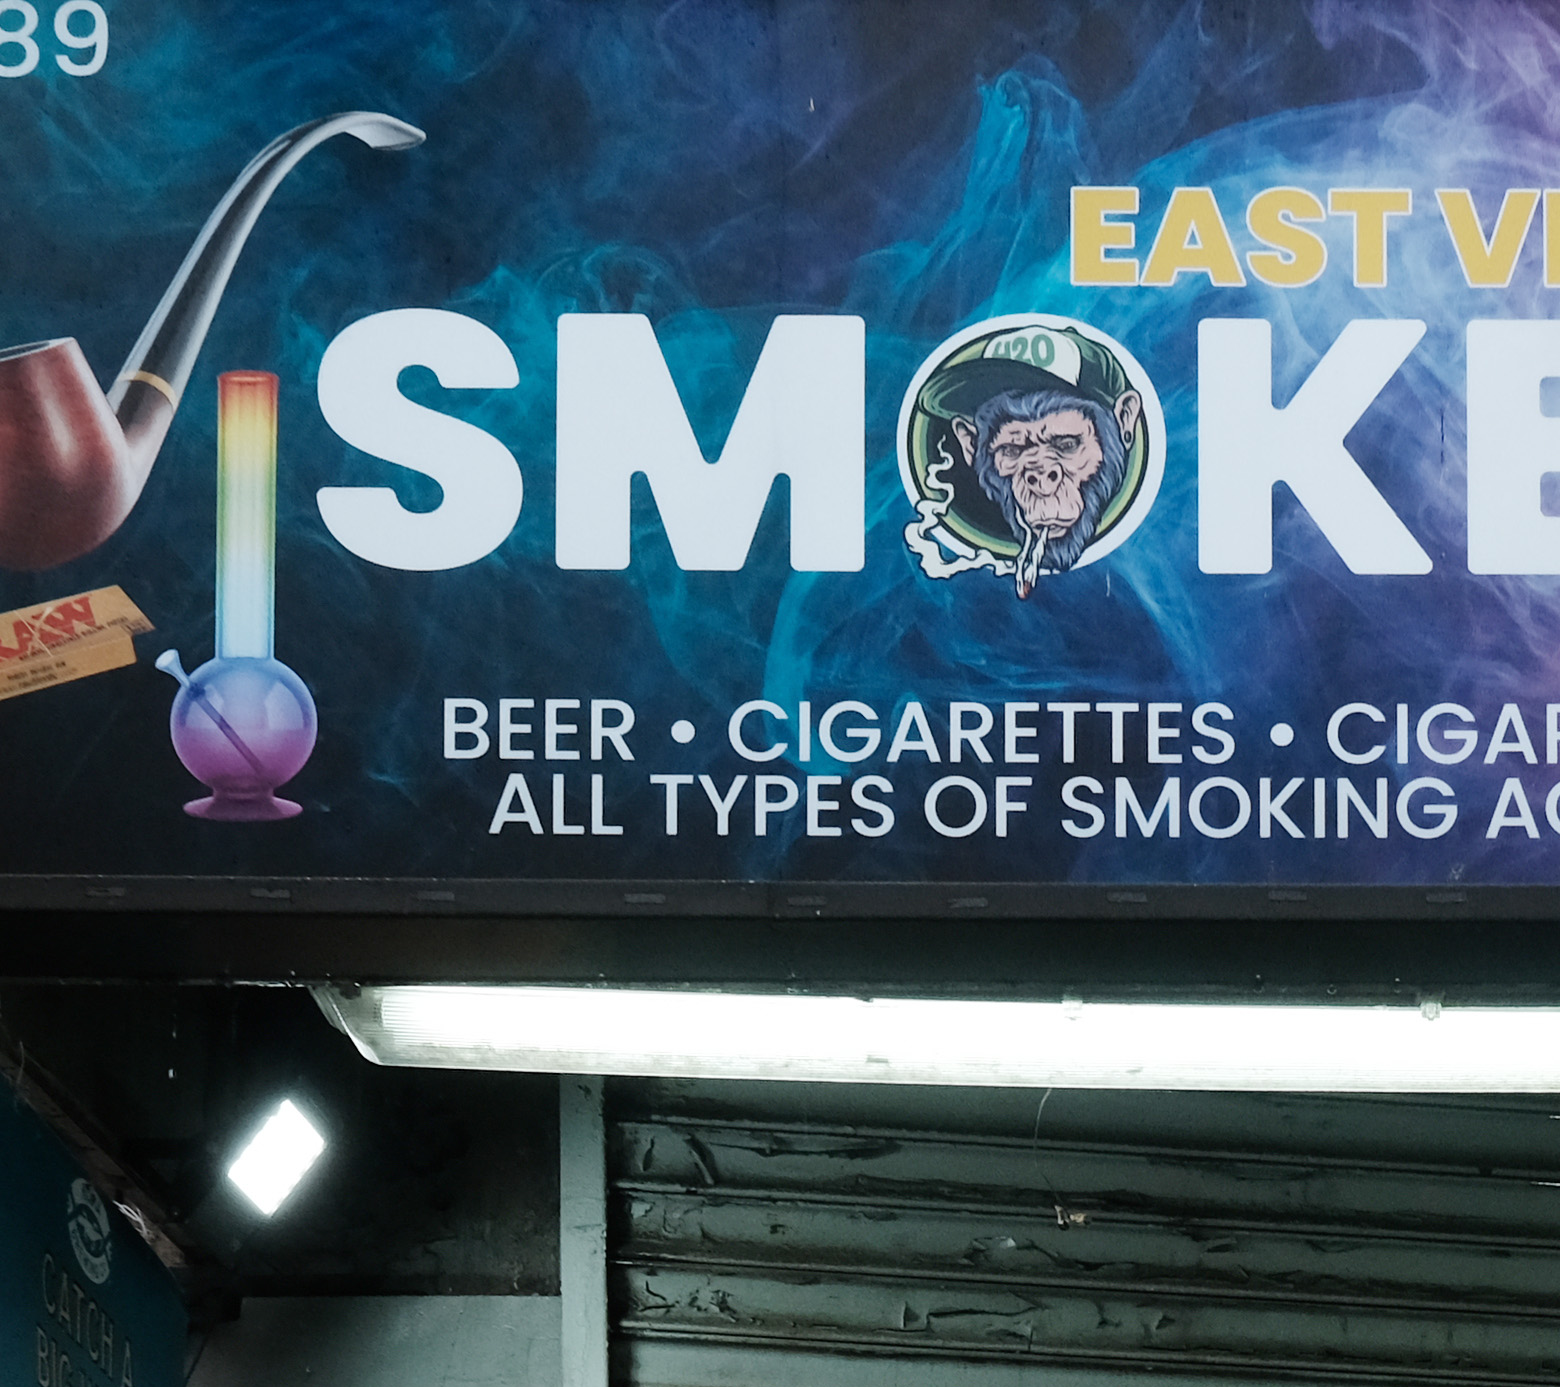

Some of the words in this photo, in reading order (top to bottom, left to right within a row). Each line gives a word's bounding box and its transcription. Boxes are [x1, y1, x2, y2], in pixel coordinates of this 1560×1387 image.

[1070, 187, 1412, 288] EAST
[443, 700, 635, 762] BEER
[727, 701, 1236, 766] CIGARETTES
[489, 776, 612, 837] ALL
[651, 776, 894, 837] TYPES
[922, 776, 1028, 838] OF
[1059, 776, 1458, 840] SMOKING
